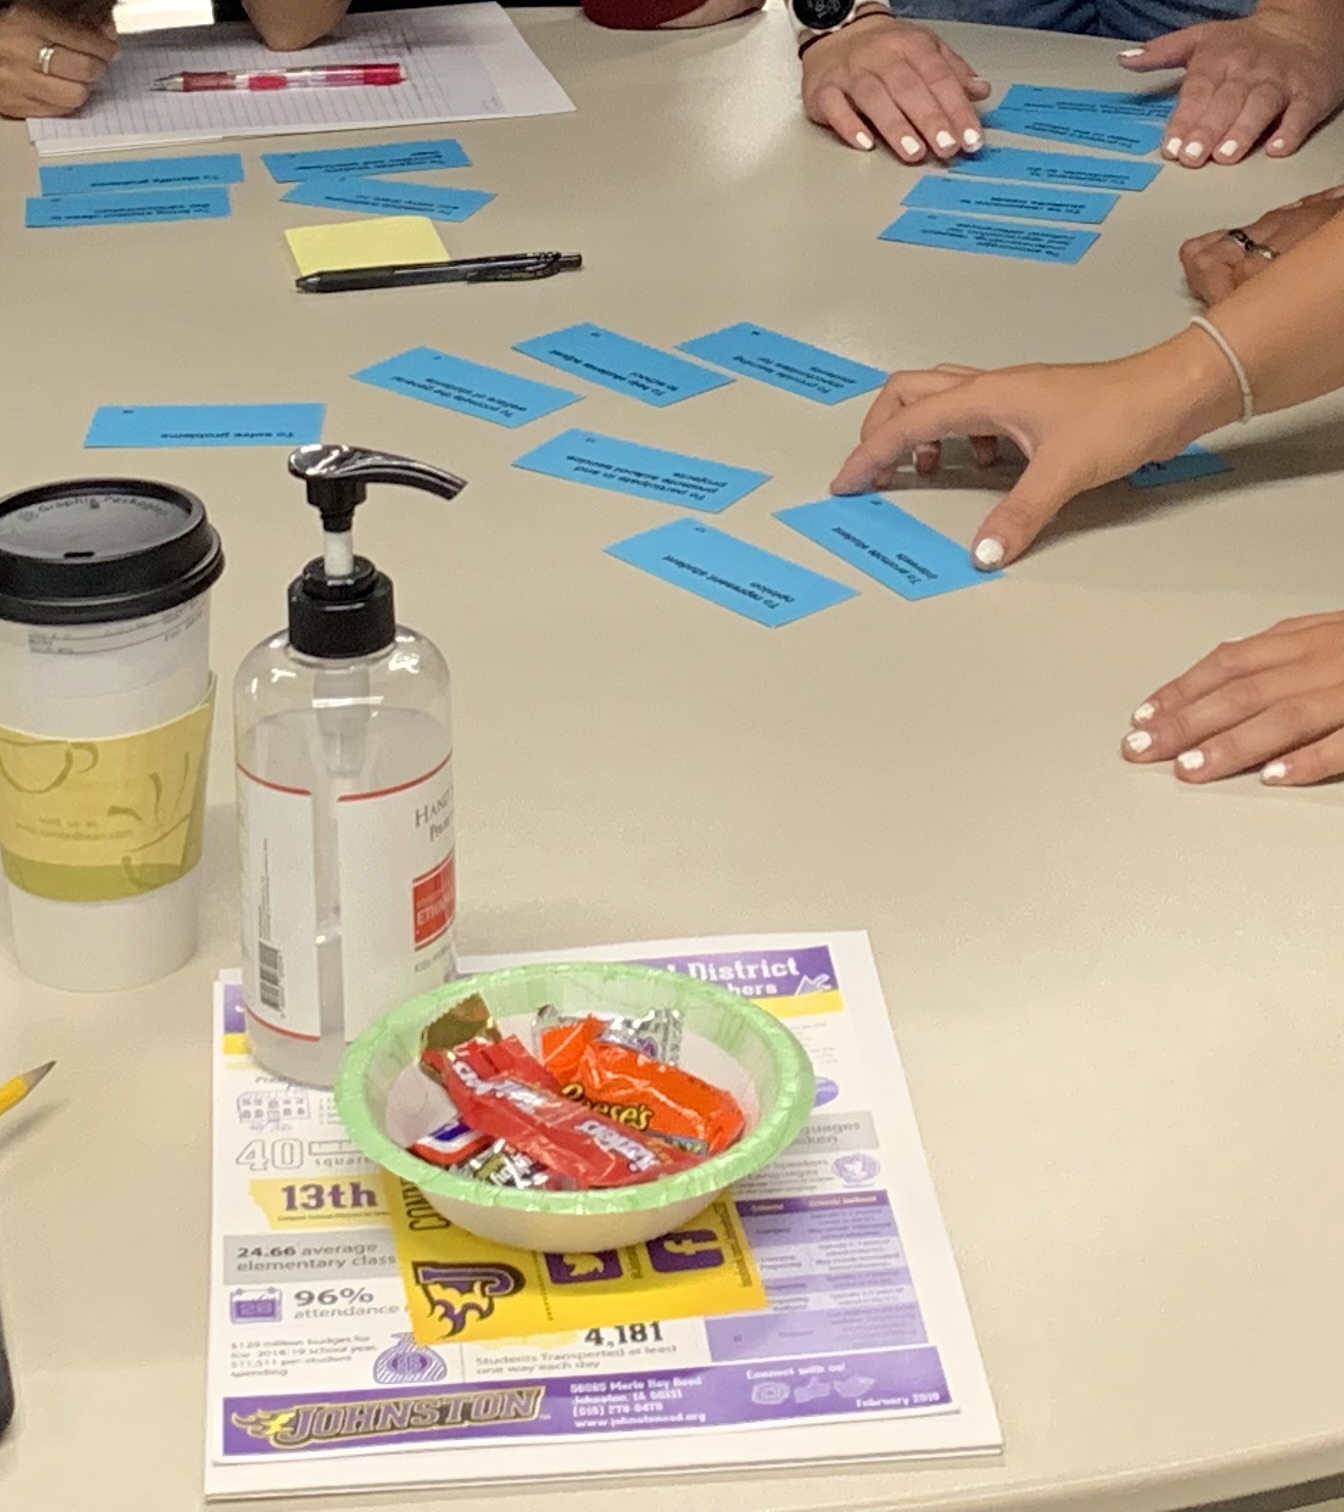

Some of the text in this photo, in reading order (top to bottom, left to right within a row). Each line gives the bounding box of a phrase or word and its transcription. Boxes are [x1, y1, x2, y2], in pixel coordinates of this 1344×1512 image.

[661, 554, 709, 579] student
[763, 598, 780, 610] To
[689, 958, 800, 982] District
[235, 1138, 305, 1172] 40
[281, 1181, 379, 1212] 13th
[237, 1242, 379, 1258] 24.66 average
[237, 1253, 398, 1272] elementary class
[294, 1287, 375, 1308] 96%
[294, 1303, 400, 1319] attendance
[584, 1320, 665, 1349] 4,181
[270, 1385, 545, 1449] JOHNSTON
